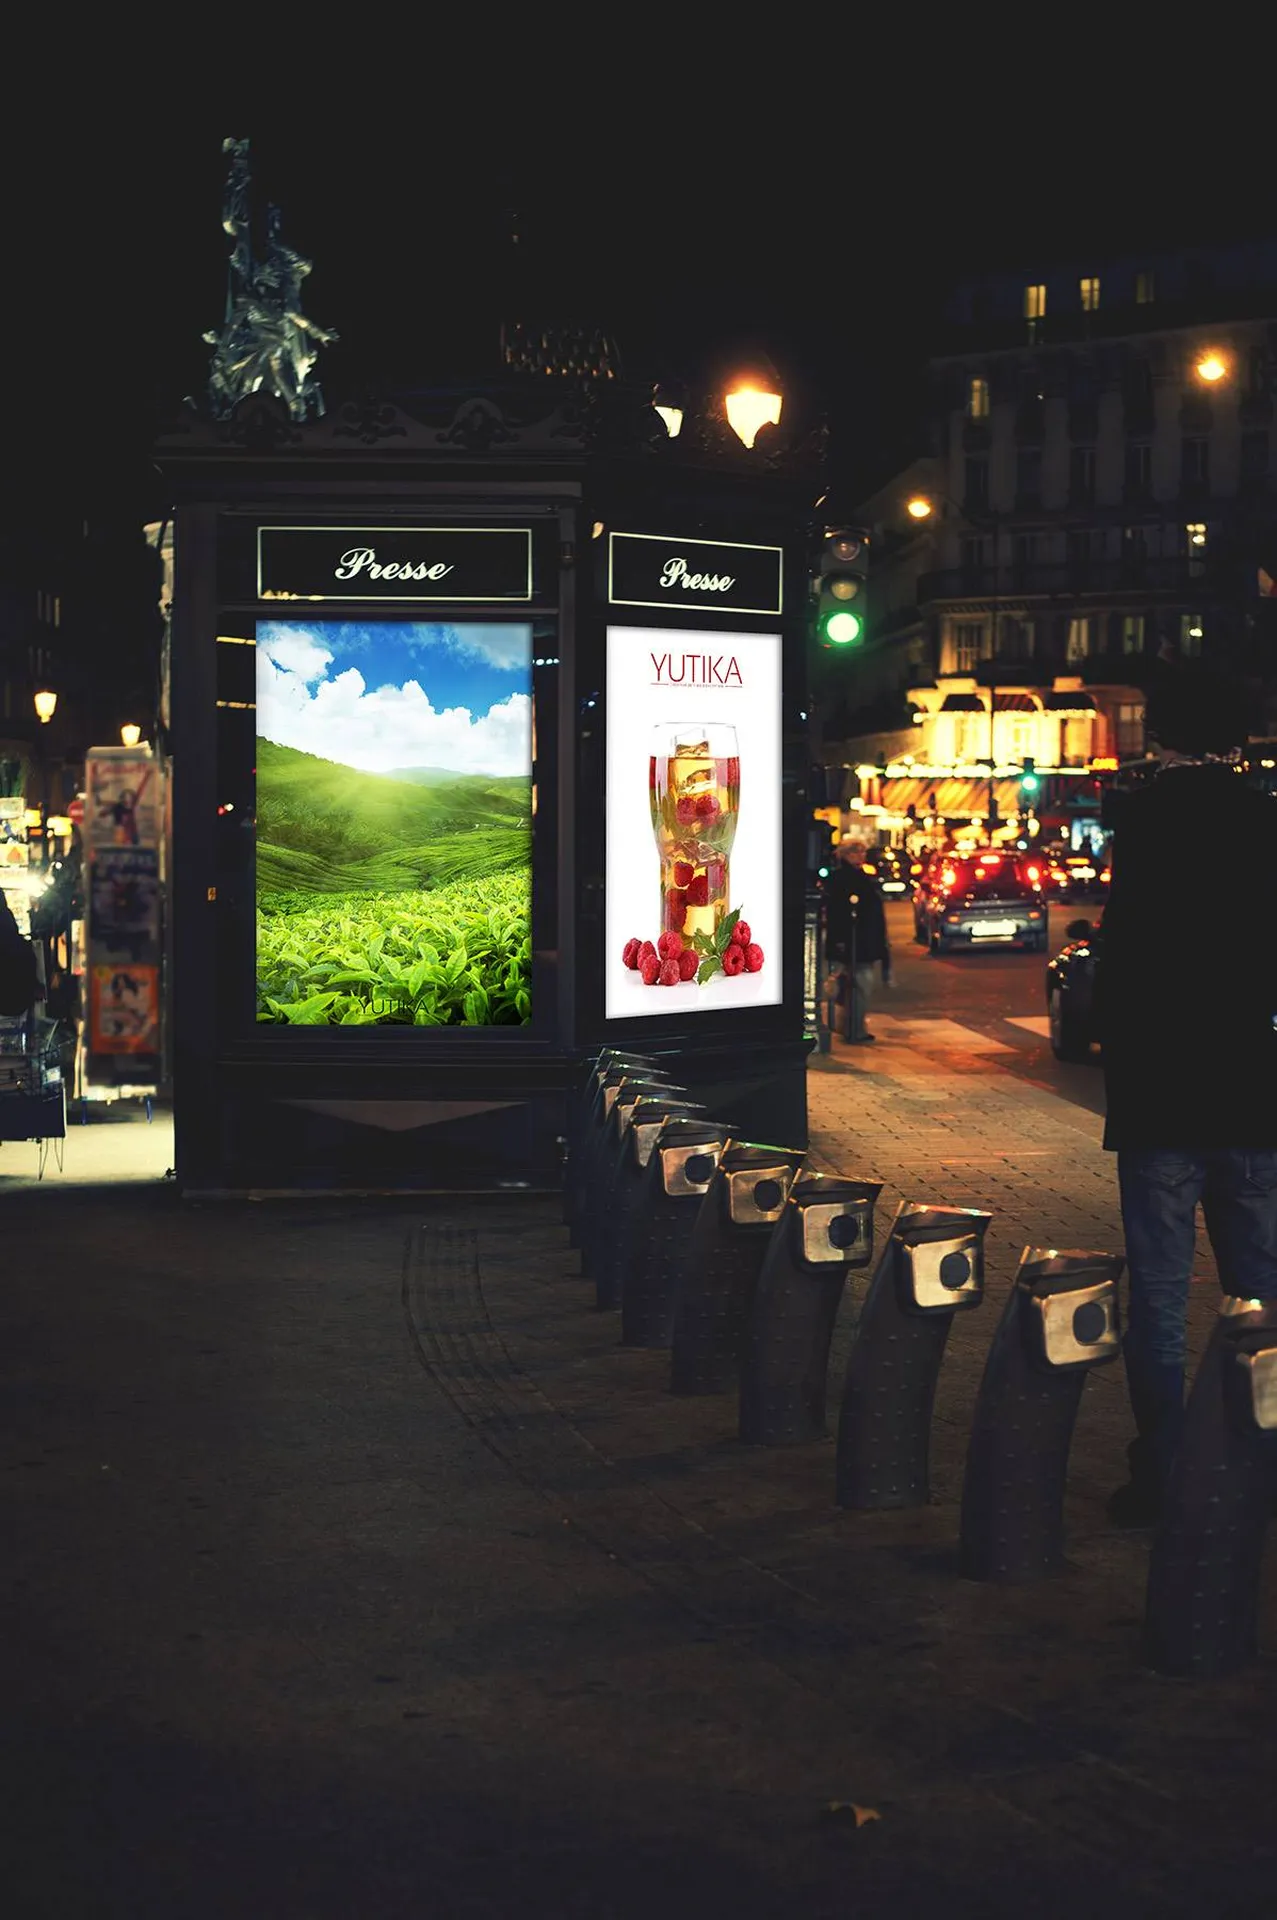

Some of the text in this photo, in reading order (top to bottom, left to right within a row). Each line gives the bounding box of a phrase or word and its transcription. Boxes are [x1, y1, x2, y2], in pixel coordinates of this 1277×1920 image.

[334, 547, 454, 581] Presse
[659, 557, 737, 593] Presse
[650, 652, 743, 685] YUTIKA
[358, 999, 430, 1015] YUTIKA
